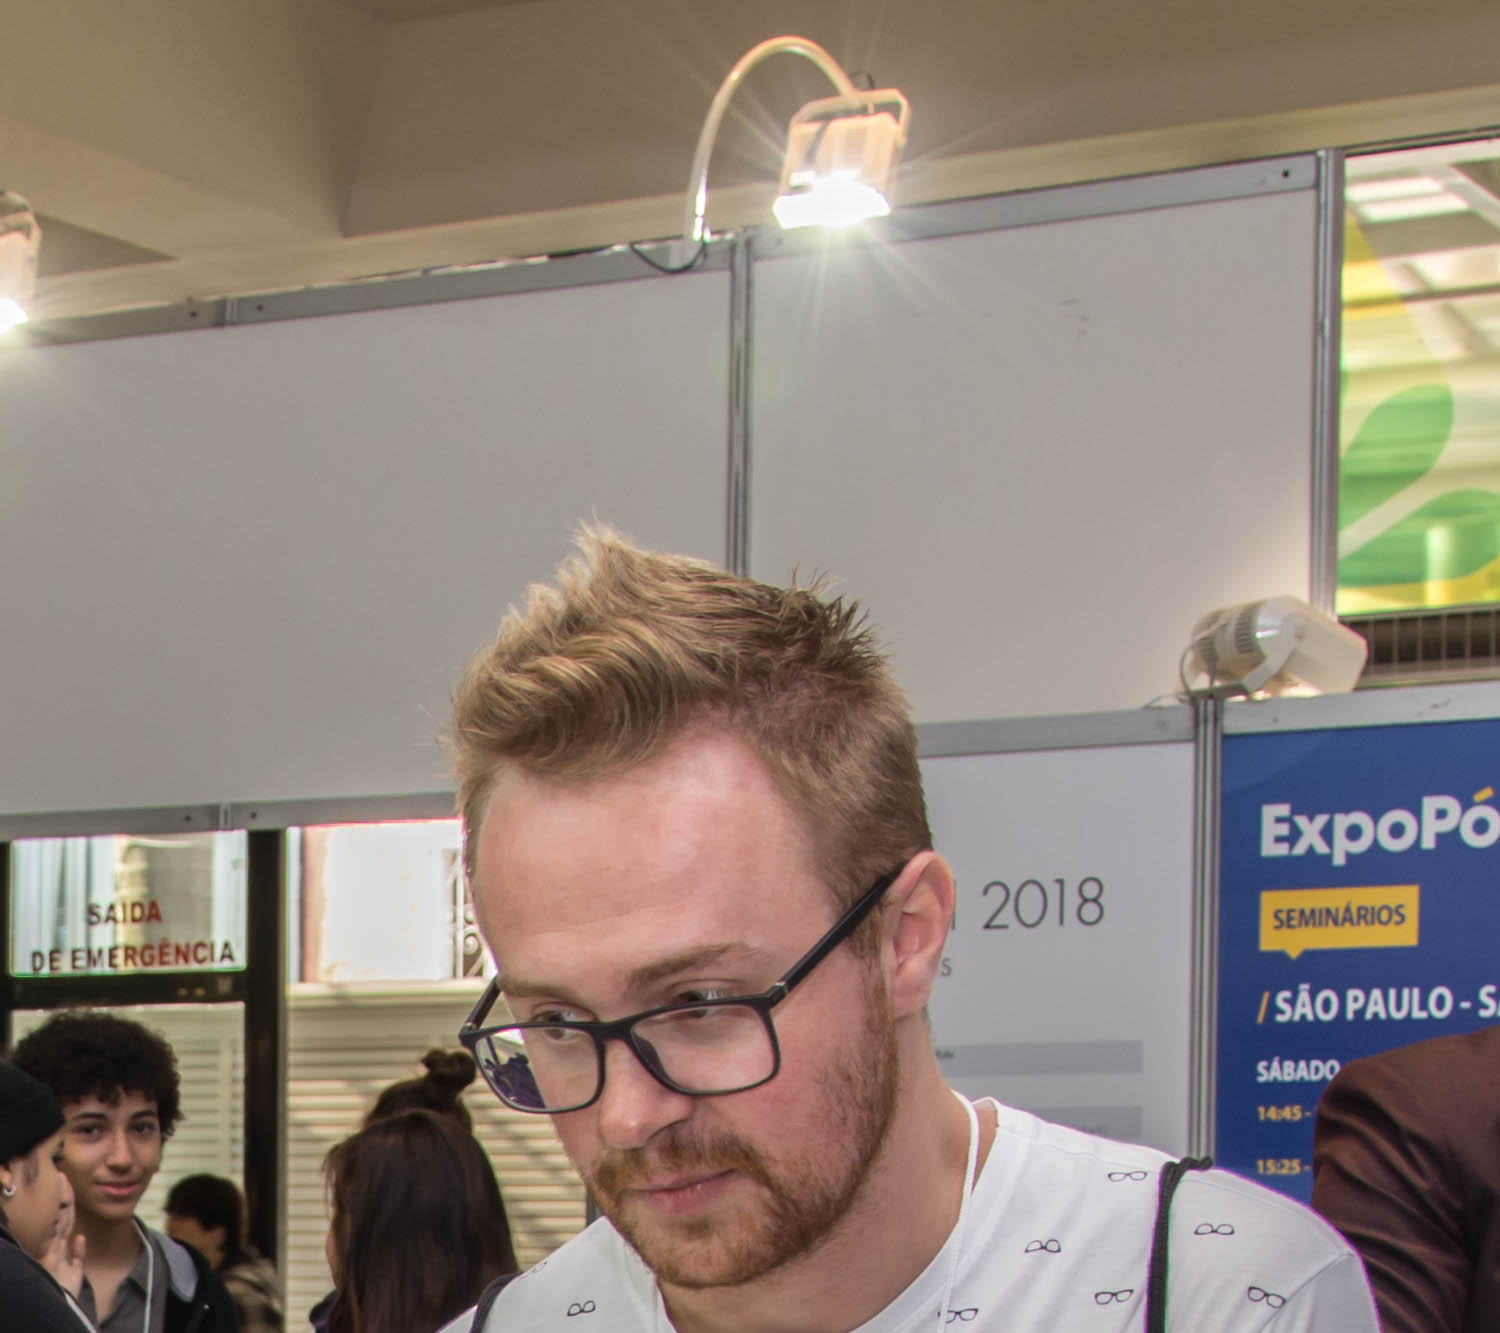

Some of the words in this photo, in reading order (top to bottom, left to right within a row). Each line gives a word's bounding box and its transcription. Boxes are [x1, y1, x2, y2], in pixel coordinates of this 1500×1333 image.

[982, 876, 1105, 931] 2018
[1273, 902, 1406, 930] SEMINÁRIOS
[31, 947, 62, 974] DE
[70, 937, 235, 970] EMERGÊNCIA
[1275, 983, 1339, 1022] SÃO
[1346, 986, 1453, 1021] PAULO
[1257, 1057, 1341, 1083] SÁBADO
[1257, 1105, 1302, 1122] 14:45
[1257, 1159, 1301, 1176] 15:25
